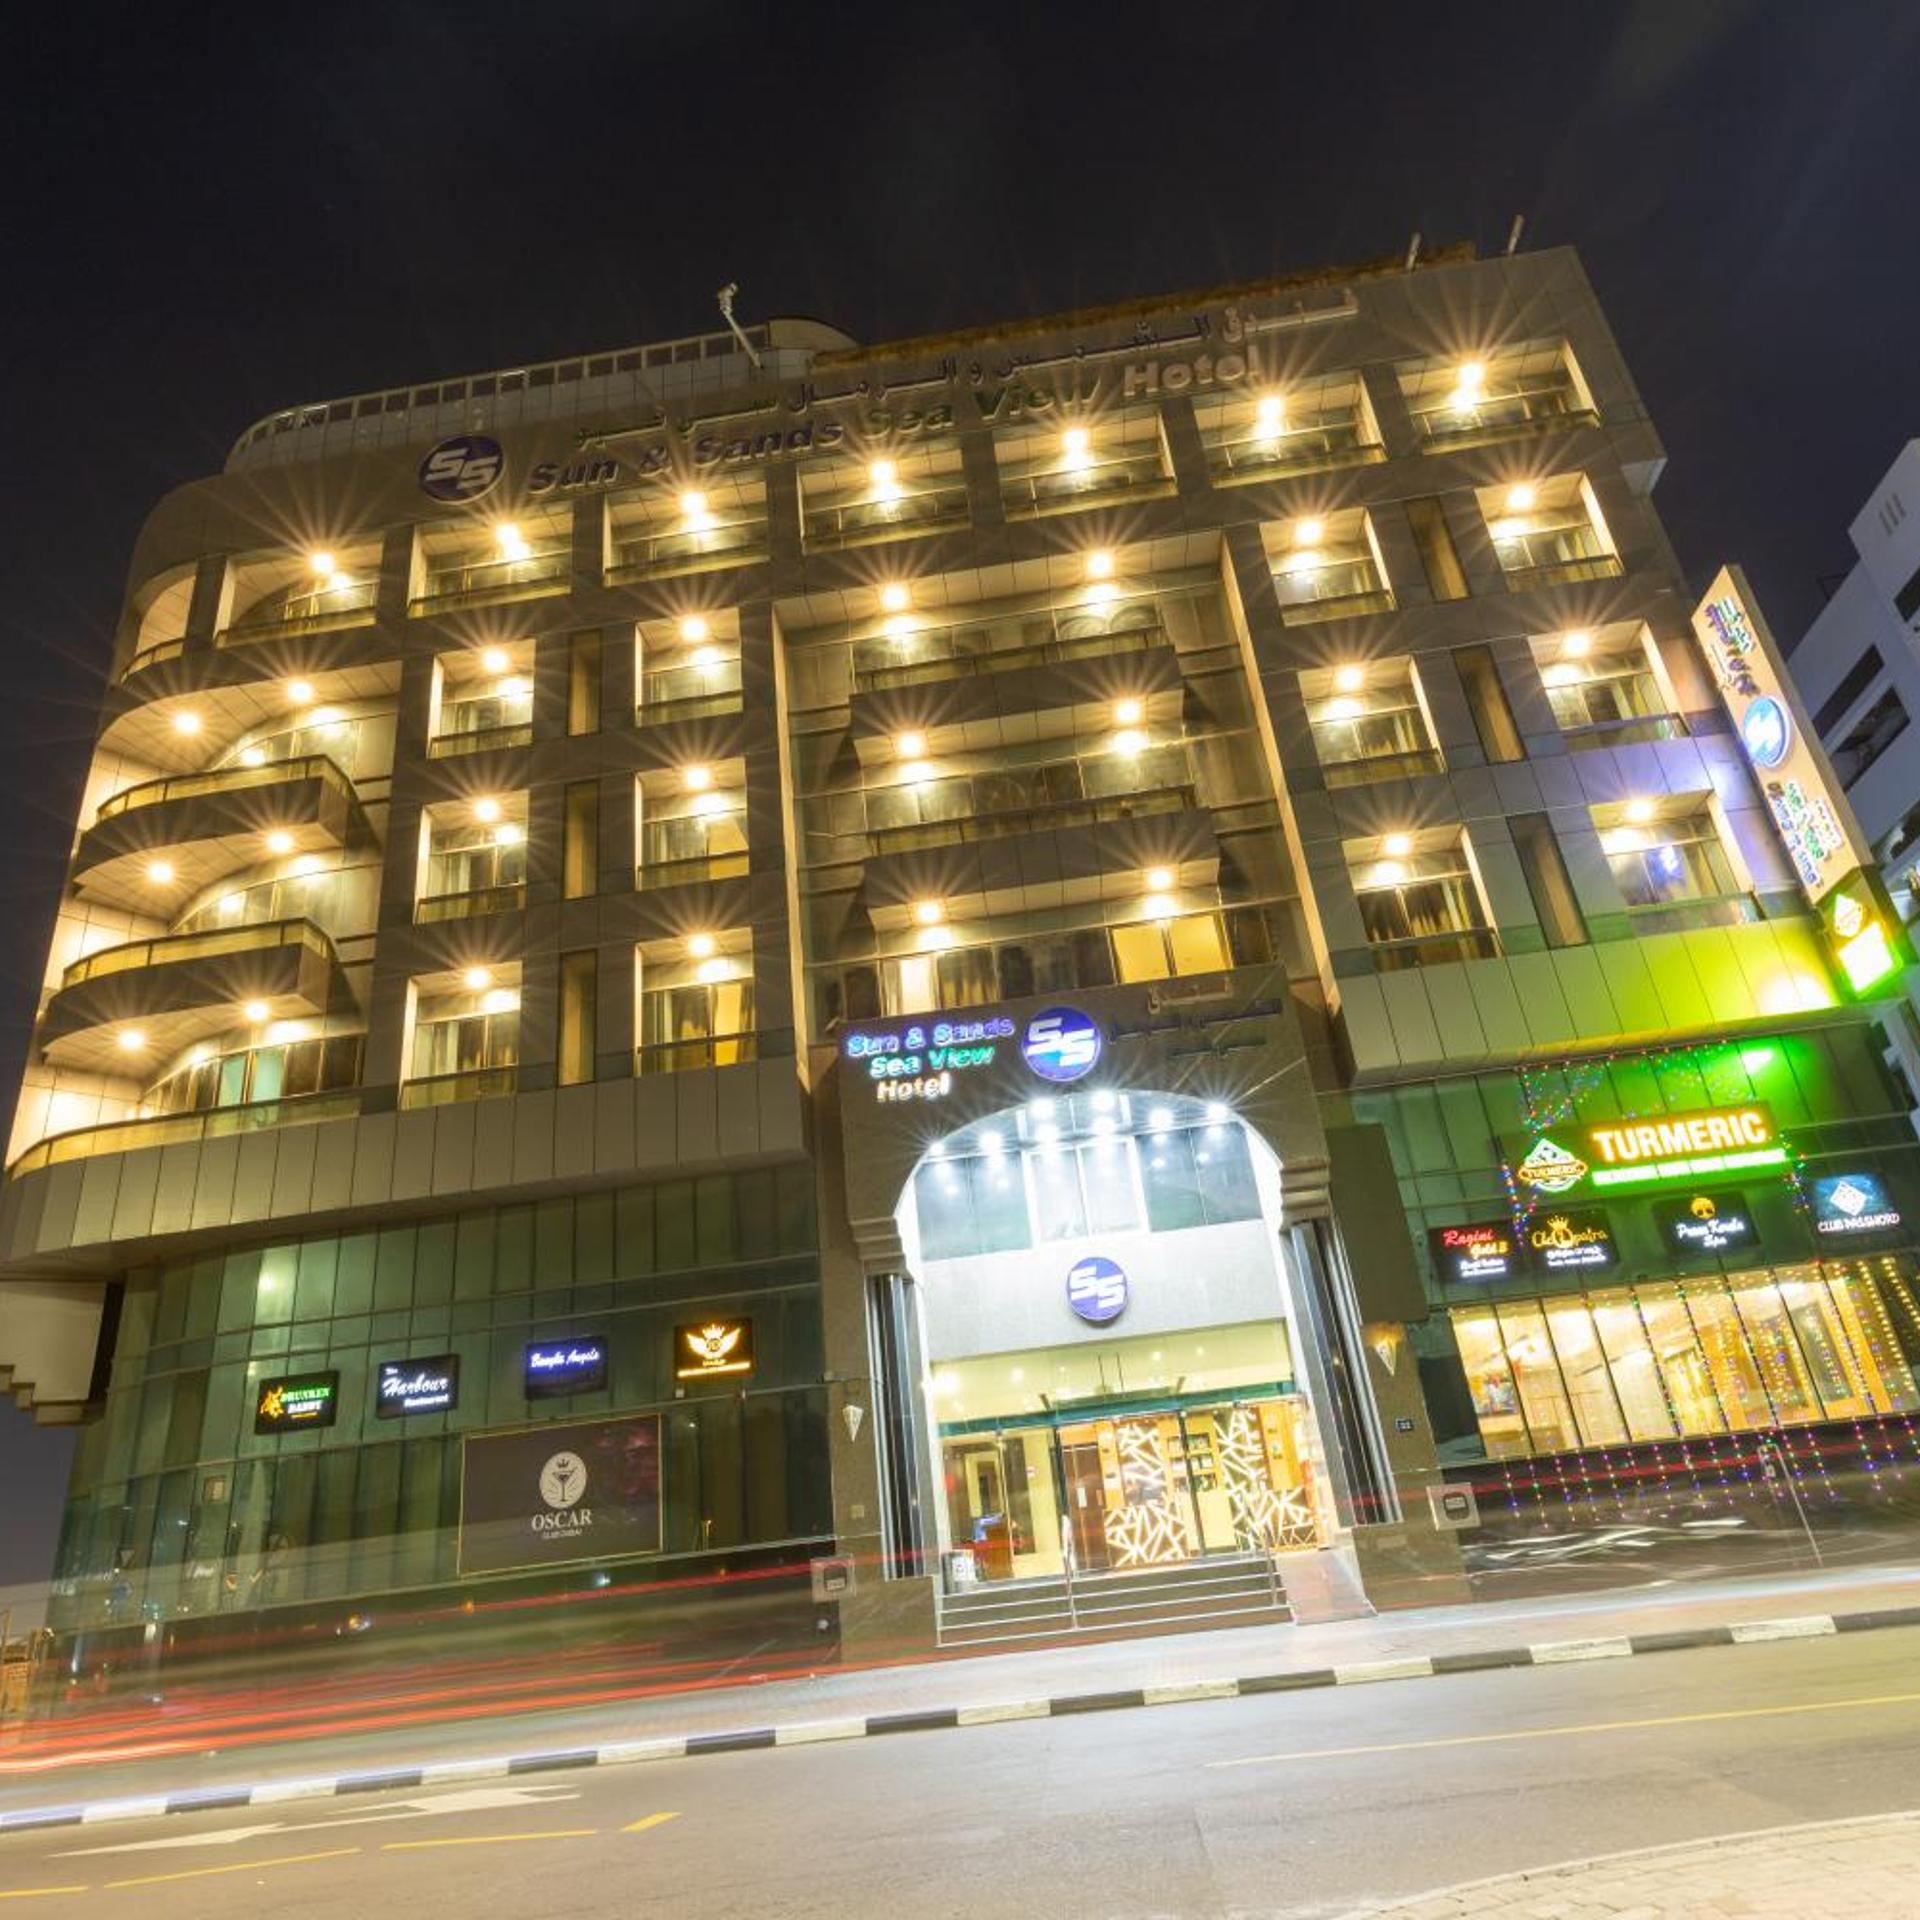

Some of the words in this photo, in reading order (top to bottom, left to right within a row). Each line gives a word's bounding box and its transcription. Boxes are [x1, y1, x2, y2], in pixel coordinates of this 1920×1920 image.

[530, 460, 620, 495] Sun
[639, 440, 674, 478] &
[696, 416, 845, 468] Sands
[865, 402, 954, 441] Sea
[1123, 343, 1258, 396] Hotel
[847, 1033, 899, 1058] Sun
[905, 1025, 927, 1049] &
[933, 1016, 1015, 1047] Sands
[870, 1054, 922, 1080] Sea
[928, 1046, 996, 1070] View
[877, 1072, 951, 1103] Hotel
[1590, 1109, 1769, 1164] TURMERIC
[382, 1372, 449, 1398] Harbour
[531, 1508, 593, 1531] OSCAR
